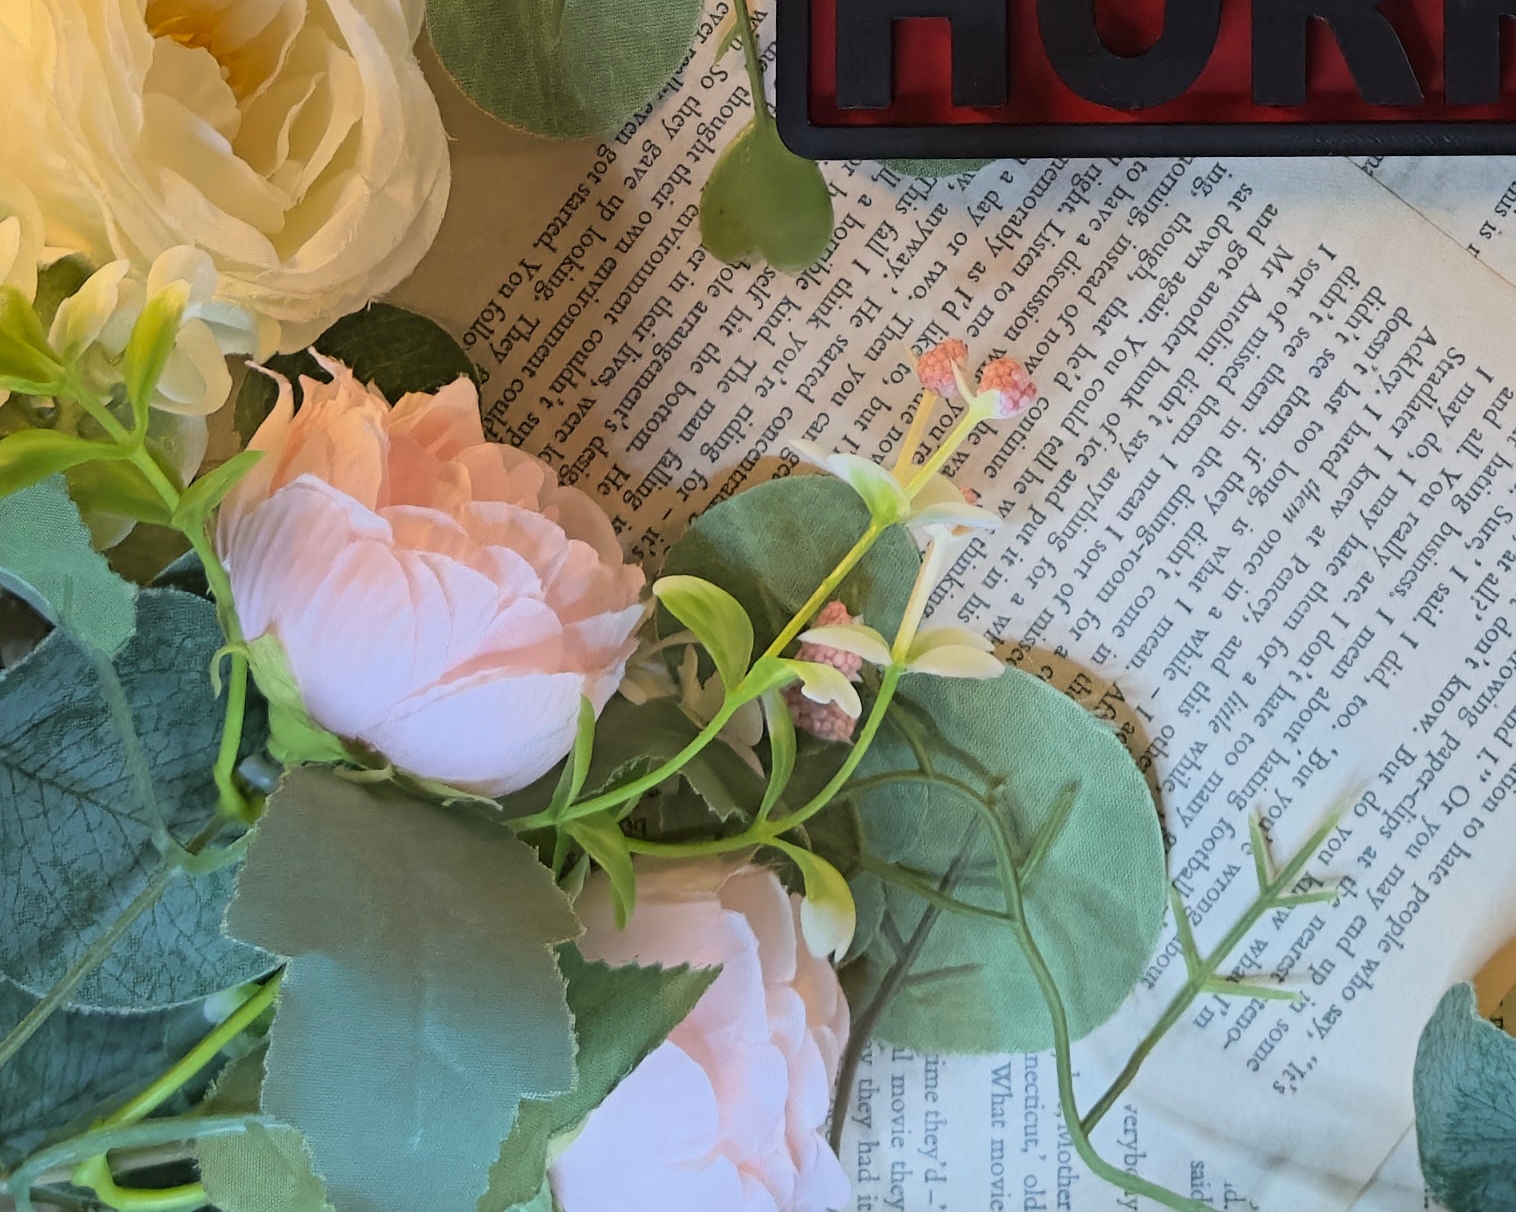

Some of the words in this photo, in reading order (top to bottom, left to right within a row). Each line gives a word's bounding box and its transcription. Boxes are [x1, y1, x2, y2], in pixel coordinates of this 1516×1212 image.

[1389, 346, 1466, 439] Stradlater
[1373, 443, 1394, 462] I
[1330, 462, 1381, 519] knew
[1305, 524, 1325, 547] at
[1242, 554, 1310, 623] Pencey,
[1449, 564, 1469, 583] I
[1412, 582, 1450, 628] said.
[1399, 631, 1419, 649] I
[1363, 650, 1403, 689] did,
[1331, 694, 1368, 729] too.
[1463, 817, 1484, 838] to
[1428, 841, 1471, 885] hate
[1377, 881, 1430, 953] people
[1341, 959, 1380, 1001] who
[1307, 1003, 1342, 1040] say,
[990, 1061, 1013, 1128] What
[989, 1138, 1011, 1211] movie
